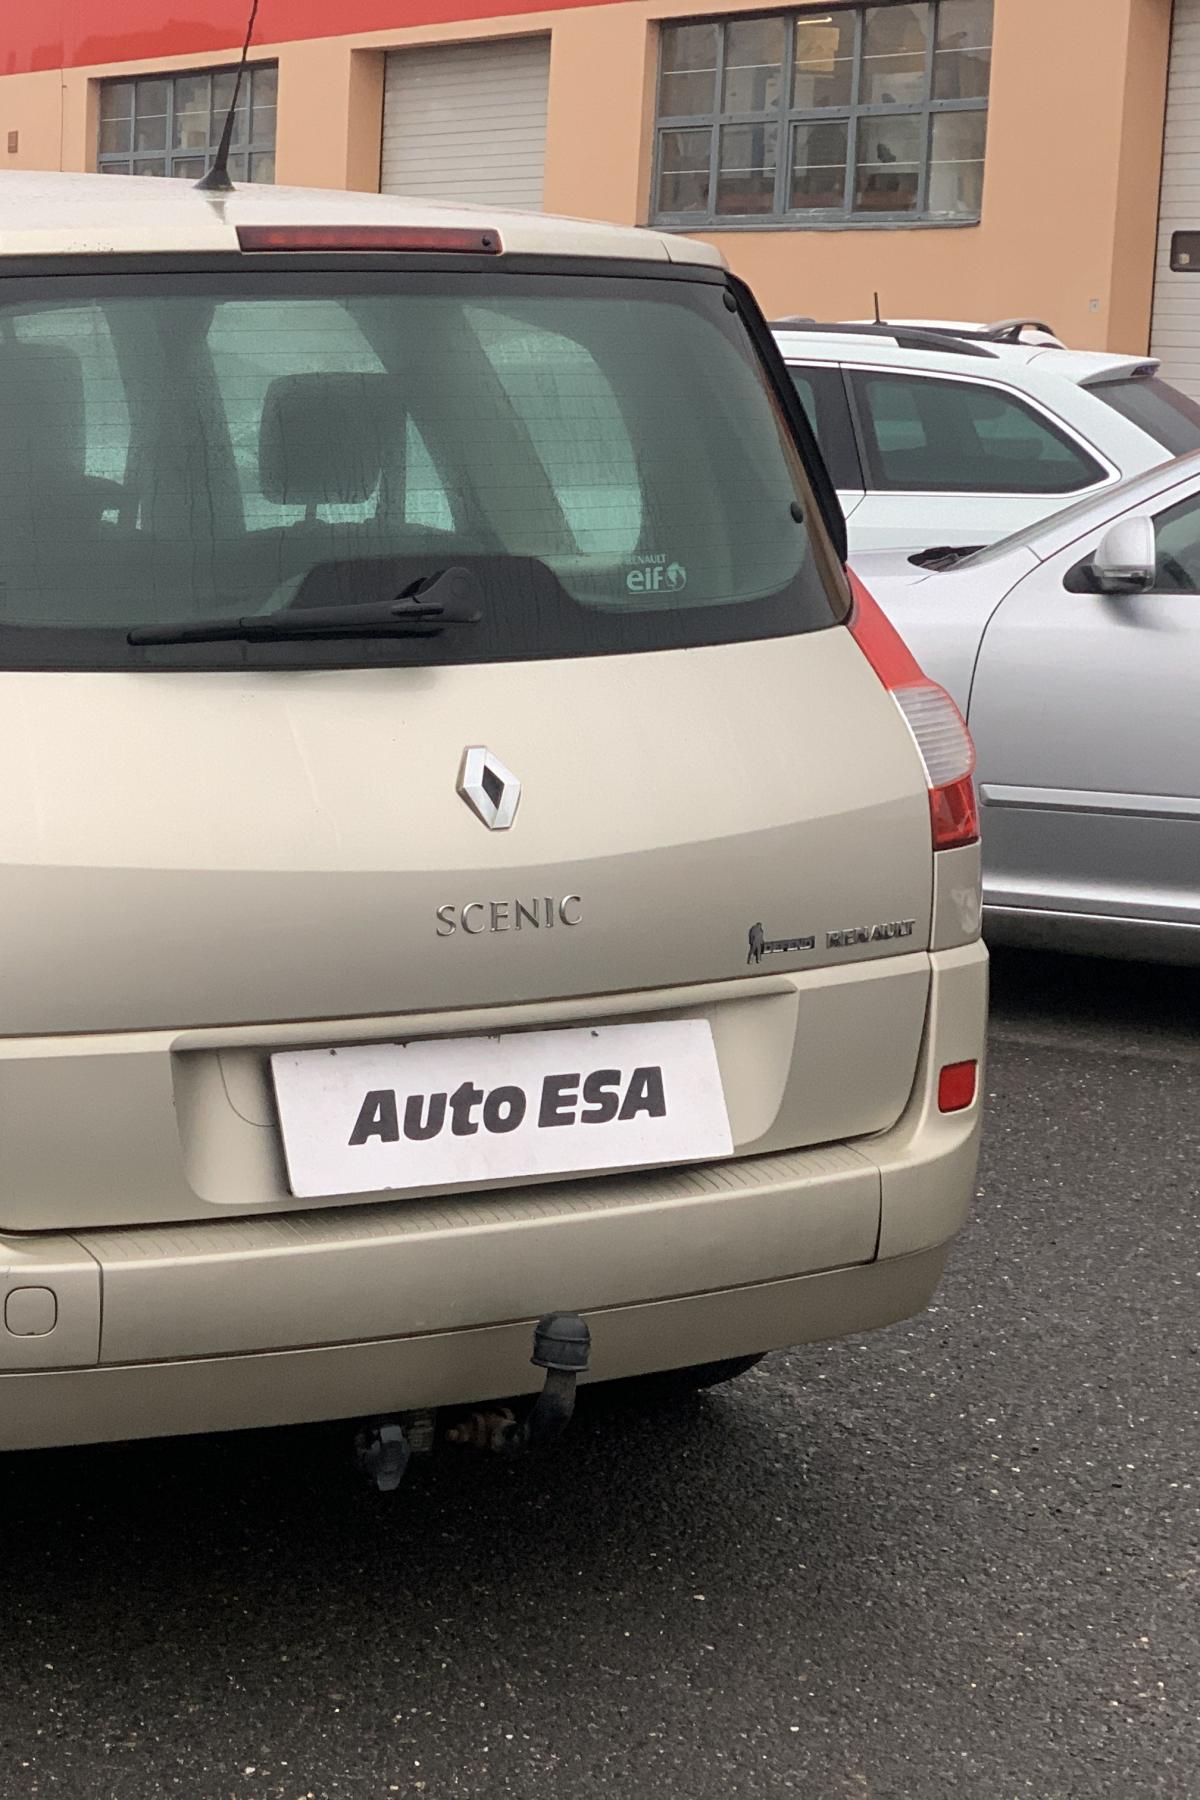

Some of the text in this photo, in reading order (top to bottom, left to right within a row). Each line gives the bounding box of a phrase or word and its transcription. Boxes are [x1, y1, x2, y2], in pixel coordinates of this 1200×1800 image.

[436, 894, 583, 937] SCENIC
[826, 918, 916, 950] RENAULT
[348, 1066, 666, 1146] Auto ESA
